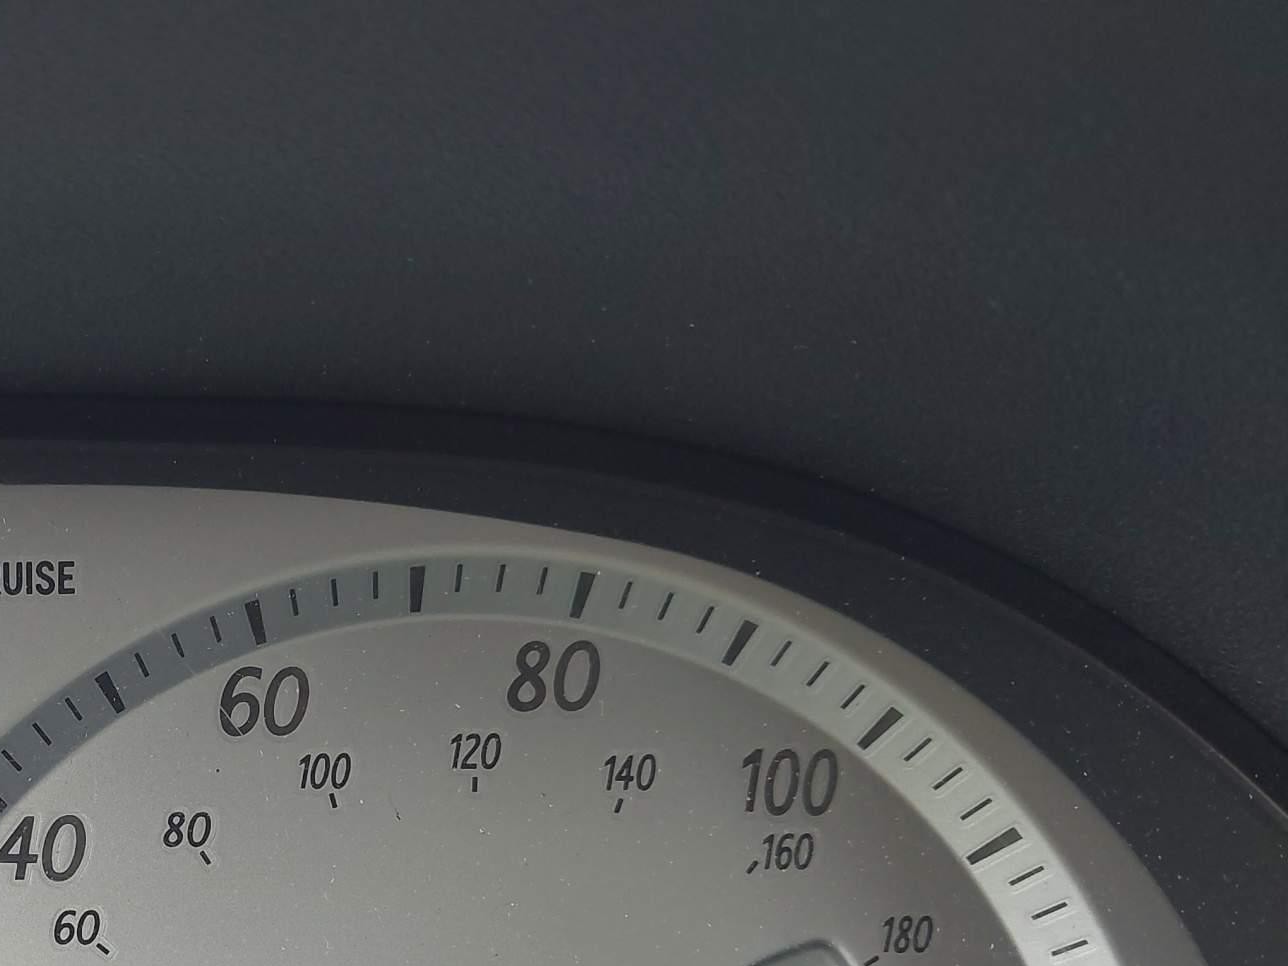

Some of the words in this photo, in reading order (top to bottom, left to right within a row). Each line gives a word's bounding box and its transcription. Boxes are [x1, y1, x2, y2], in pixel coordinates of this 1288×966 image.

[507, 640, 600, 712] 80
[220, 667, 309, 736] 60
[451, 733, 501, 769] 120
[300, 753, 351, 789] 100
[605, 754, 656, 791] 140
[743, 749, 838, 816] 100
[163, 812, 211, 847] 80
[760, 835, 814, 869] 160
[54, 910, 99, 945] 60
[884, 916, 933, 953] 180
